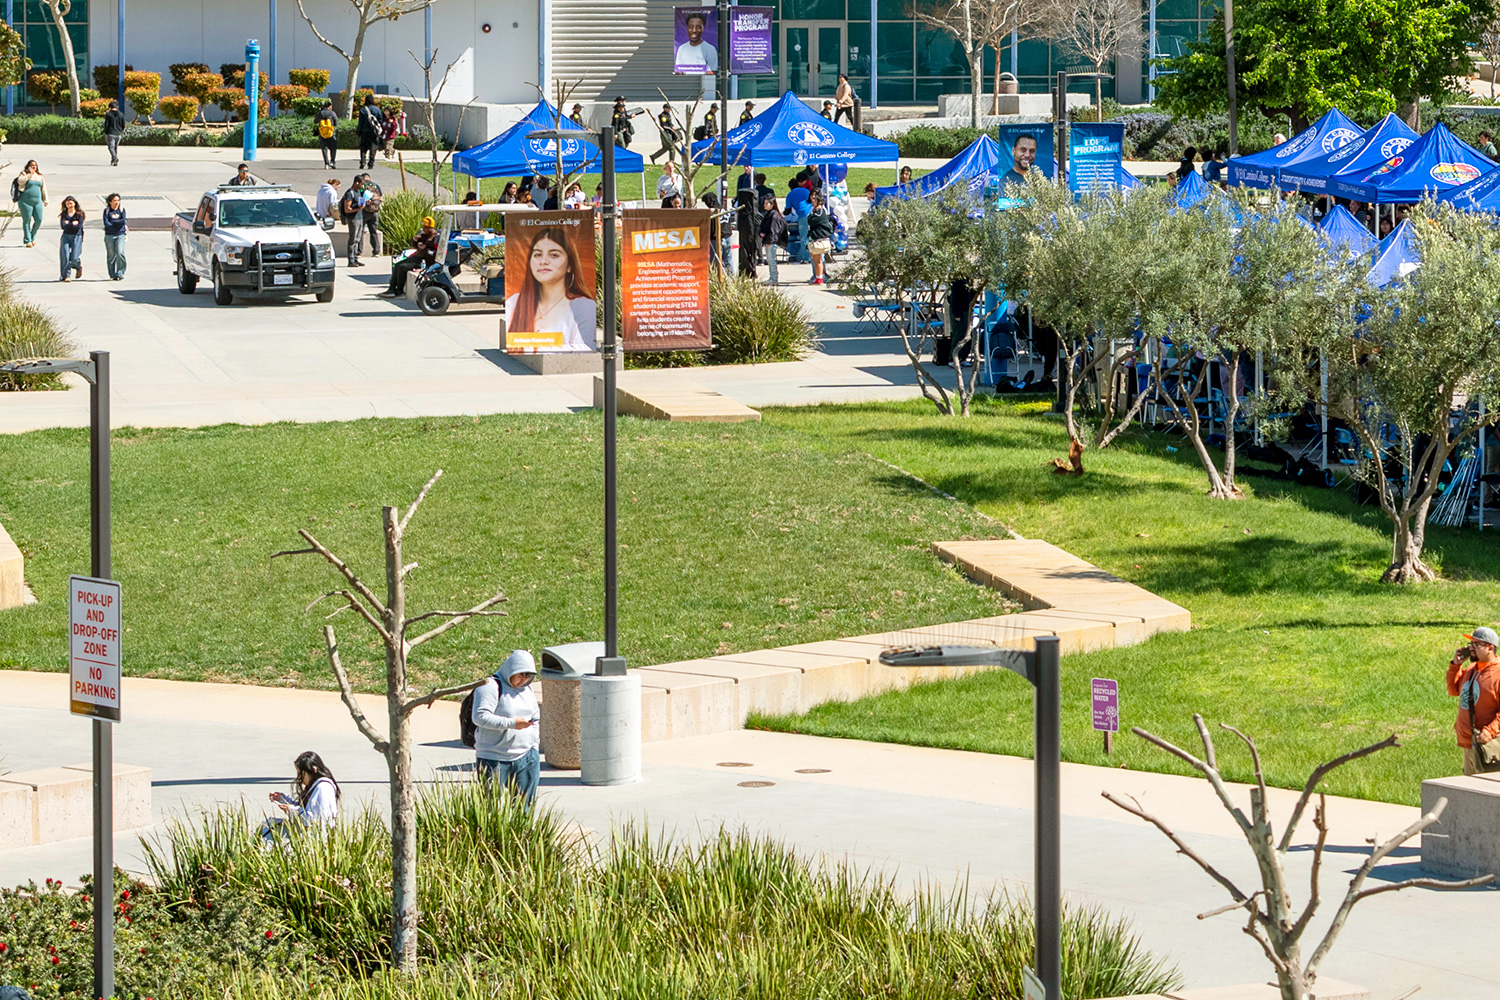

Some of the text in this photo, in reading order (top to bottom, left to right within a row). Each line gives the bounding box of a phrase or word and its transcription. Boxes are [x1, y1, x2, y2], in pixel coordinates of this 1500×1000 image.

[733, 18, 769, 27] TRANSFER
[738, 13, 764, 21] HONOR
[734, 23, 769, 32] PROGRAM
[1074, 142, 1118, 154] PROGRAM
[1084, 138, 1106, 147] EOPS
[815, 152, 836, 160] Camino
[837, 150, 857, 161] College
[558, 217, 580, 227] College
[634, 229, 698, 251] MESA
[663, 288, 698, 296] opportunities
[651, 309, 674, 317] Program
[77, 590, 113, 608] PICK-UP
[86, 608, 105, 623] AND
[73, 623, 118, 642] DROP-OFF
[83, 641, 107, 657] ZONE
[89, 666, 102, 681] NO
[75, 681, 116, 700] PARKING
